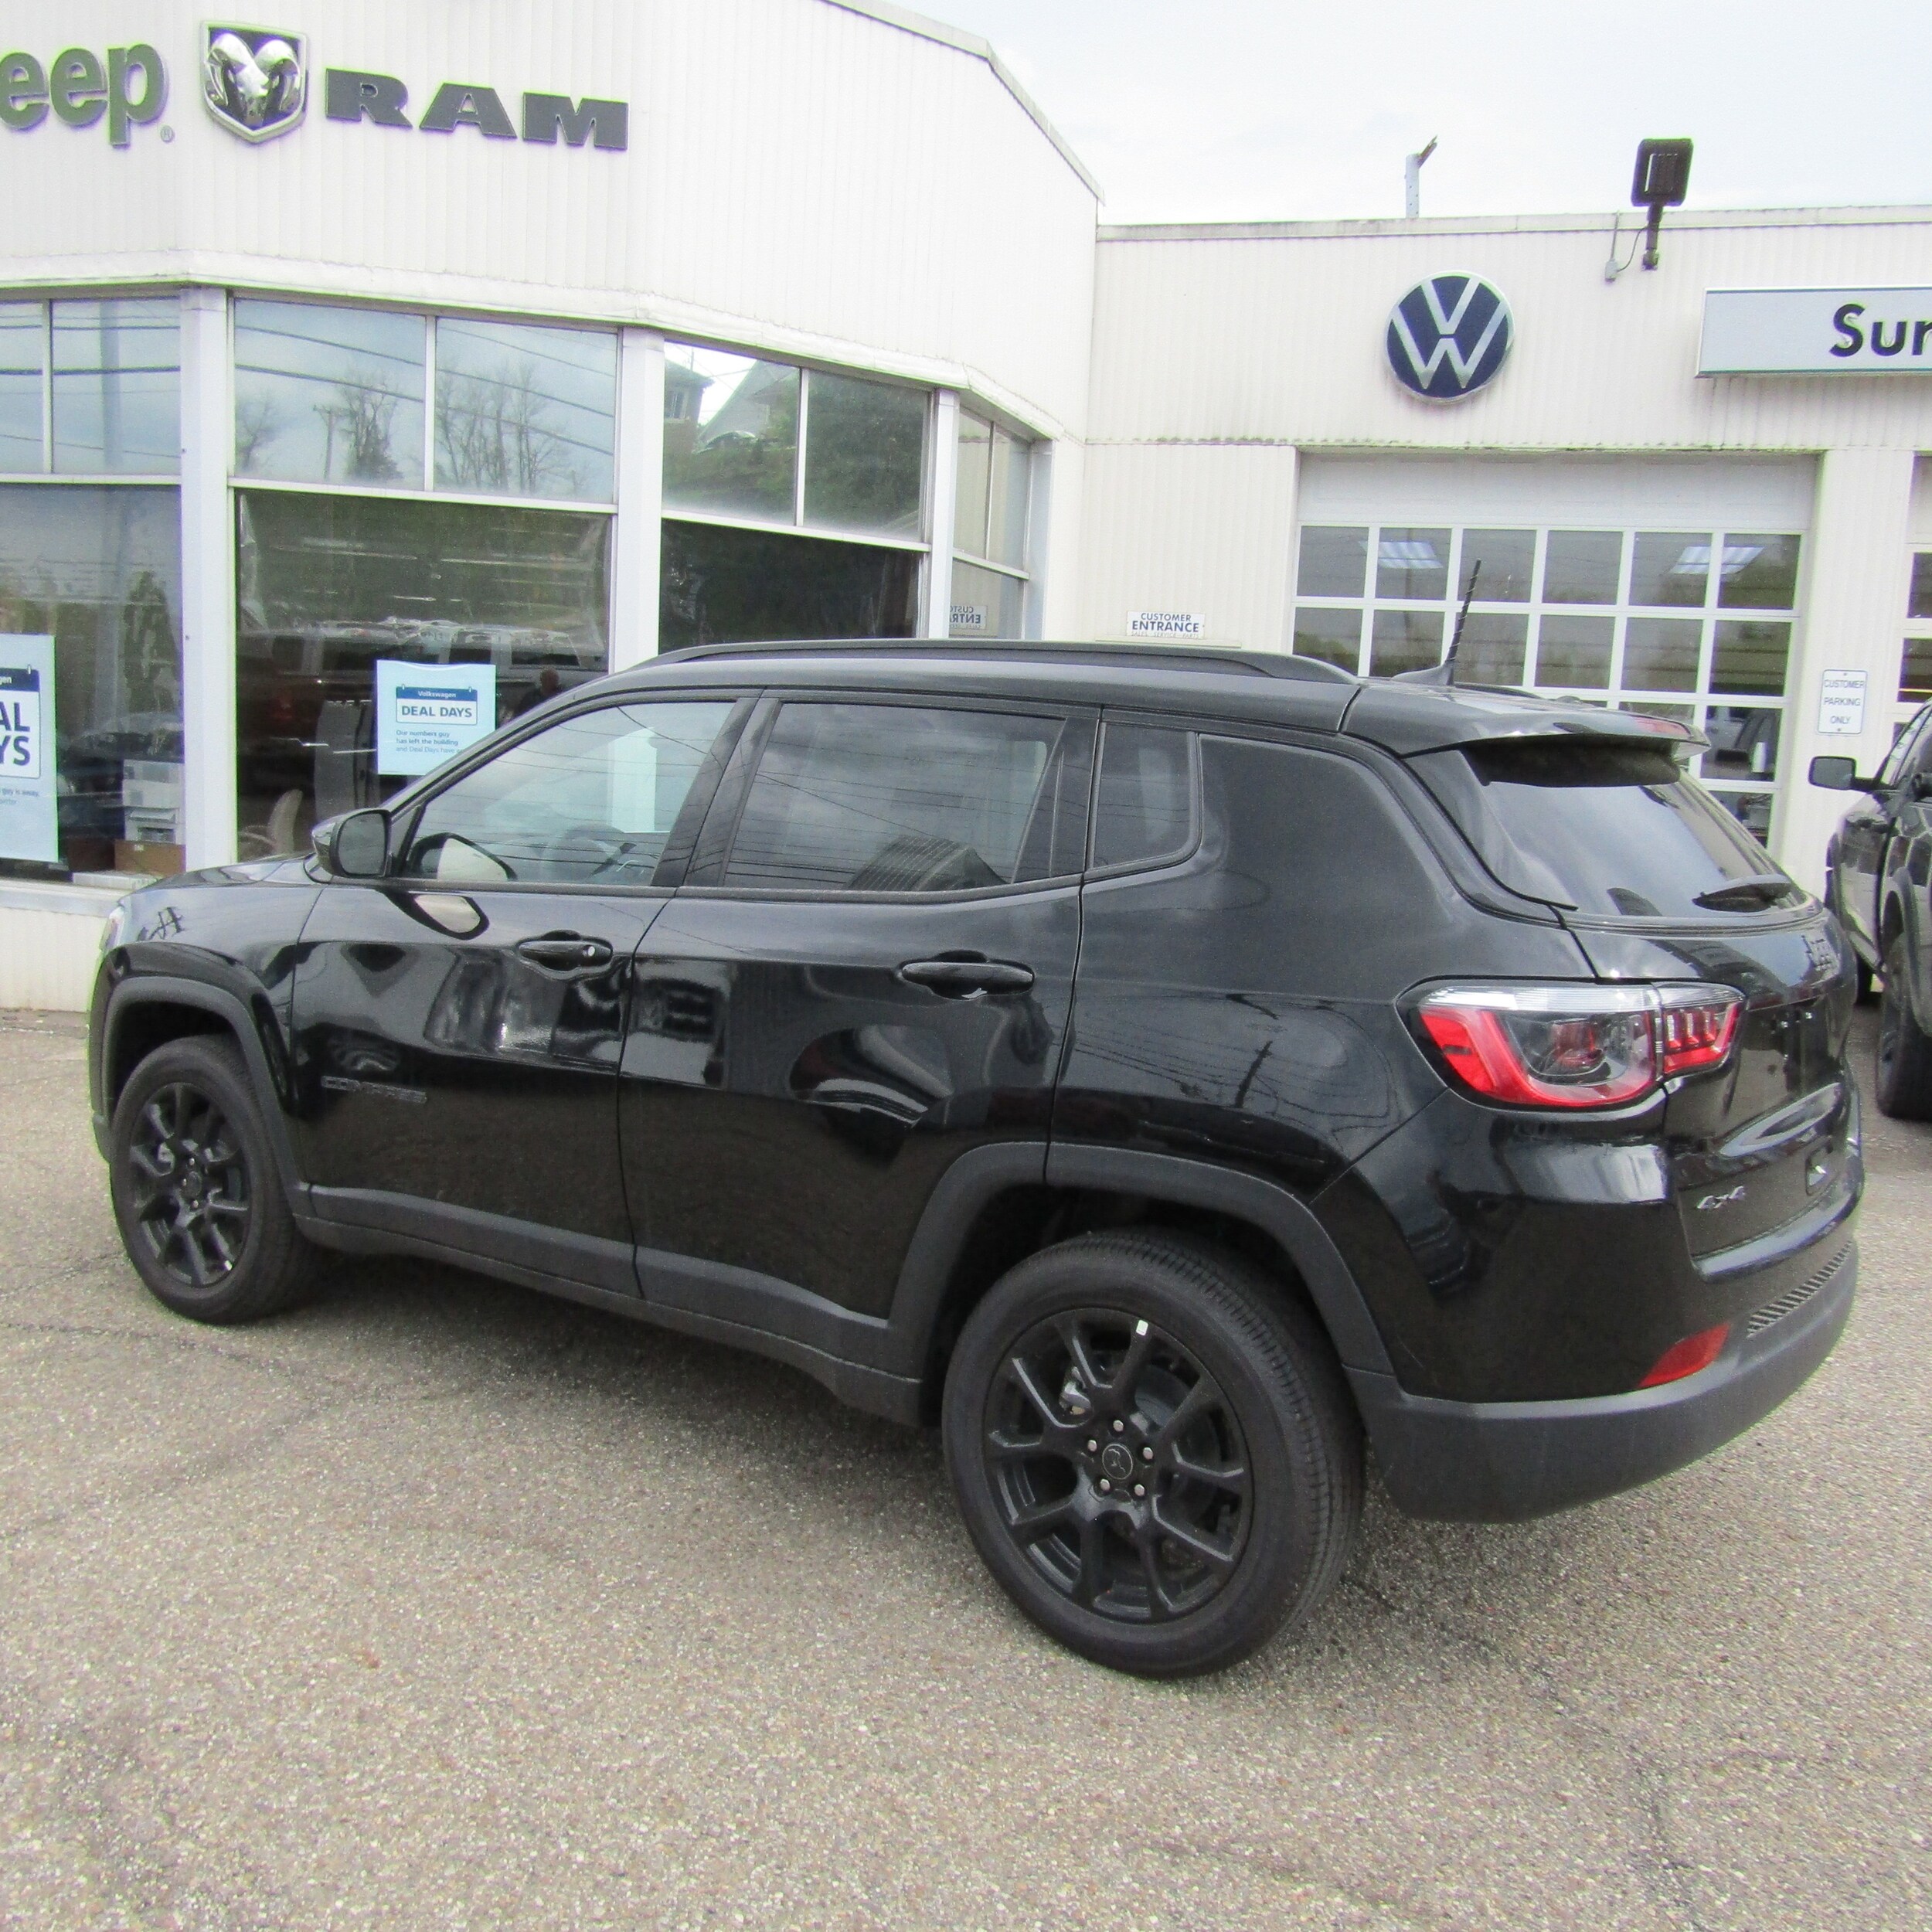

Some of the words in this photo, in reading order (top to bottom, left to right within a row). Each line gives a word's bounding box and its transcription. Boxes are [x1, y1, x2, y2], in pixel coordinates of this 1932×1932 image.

[325, 68, 629, 150] RAM
[1141, 613, 1191, 621] CUSTOMER
[1132, 621, 1199, 632] ENTRANCE
[1824, 679, 1864, 689] CUSTOMER
[1824, 697, 1861, 706] PARKING
[402, 706, 435, 716] DEAL
[440, 706, 472, 717] DAYS
[1830, 716, 1852, 724] ONLY
